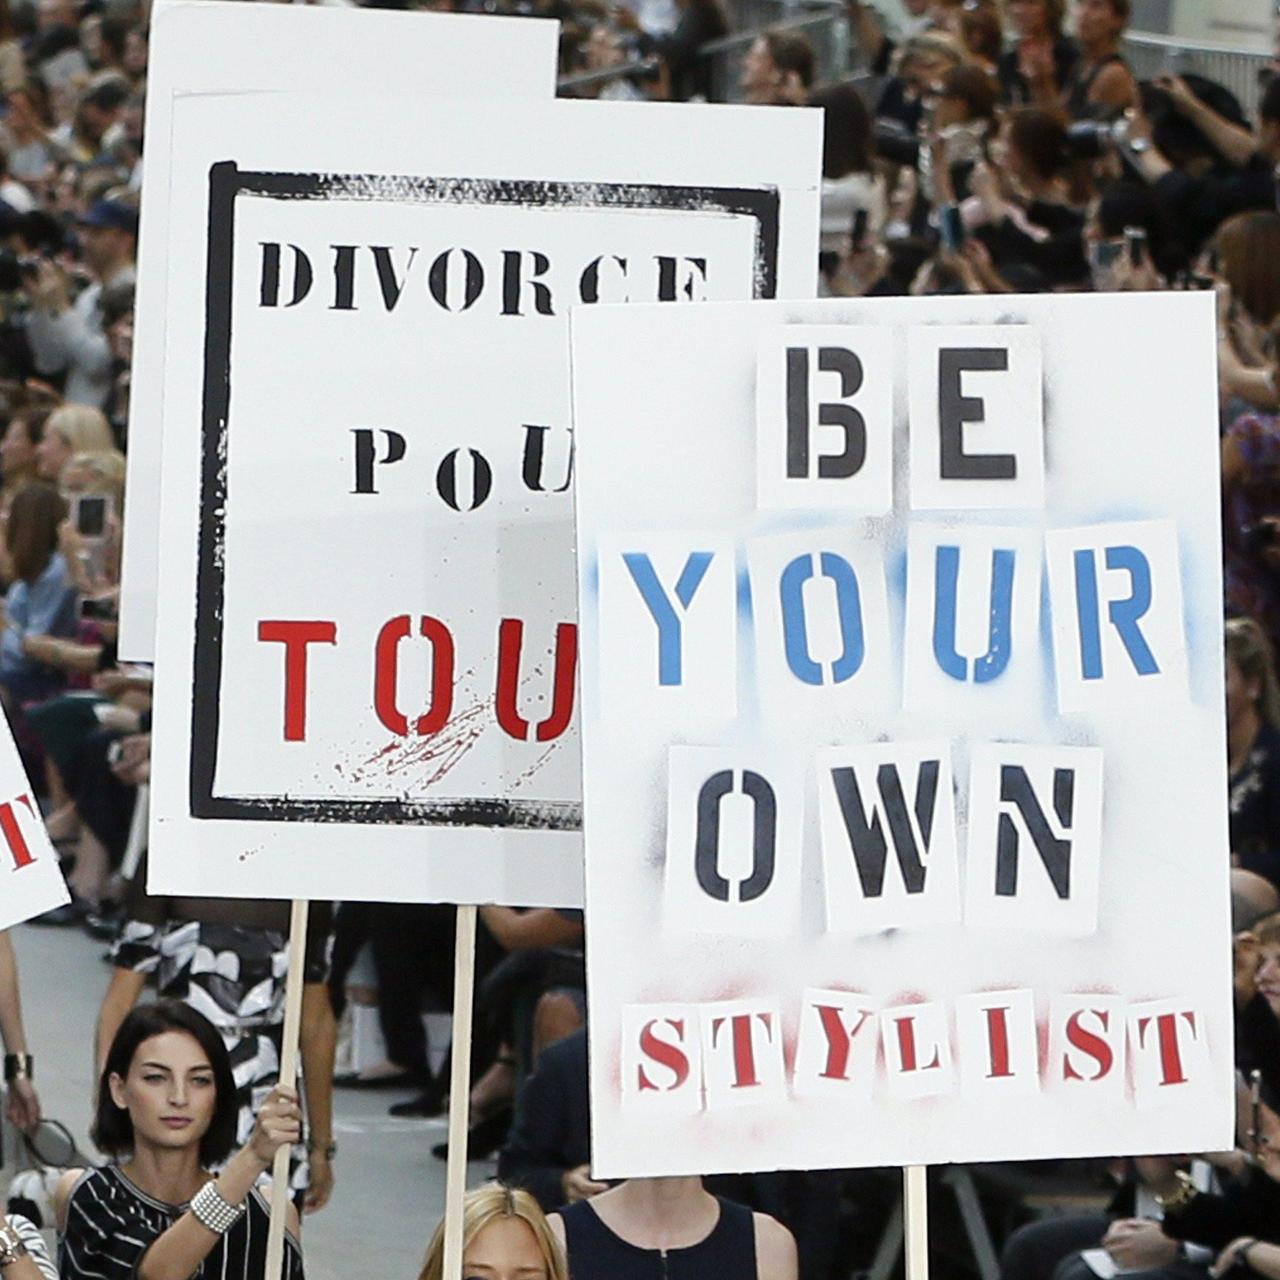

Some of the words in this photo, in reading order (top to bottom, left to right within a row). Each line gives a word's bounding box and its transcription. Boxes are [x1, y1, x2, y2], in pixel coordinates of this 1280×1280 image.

[255, 241, 709, 317] DIVORCE
[784, 346, 1018, 481] BE
[621, 543, 1162, 687] YOUR
[692, 759, 1075, 904] OWN
[637, 1004, 1200, 1093] STYLIST
